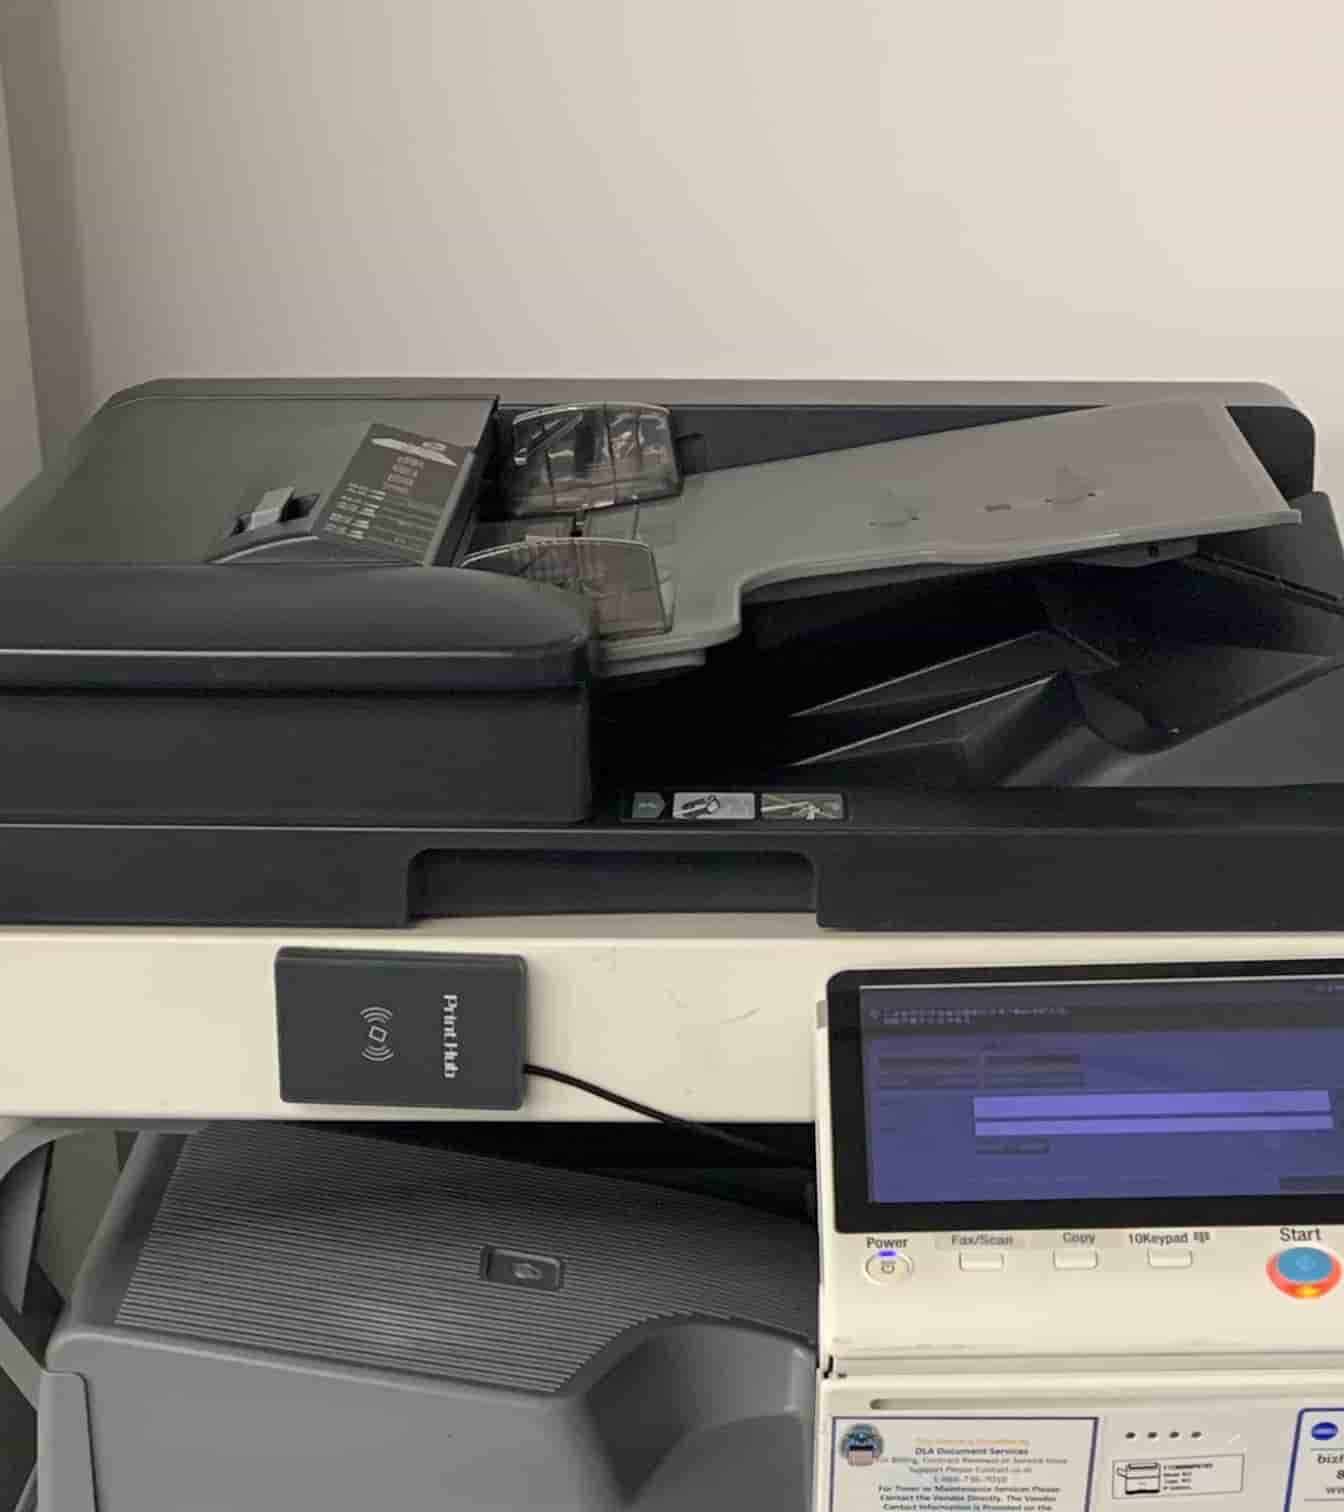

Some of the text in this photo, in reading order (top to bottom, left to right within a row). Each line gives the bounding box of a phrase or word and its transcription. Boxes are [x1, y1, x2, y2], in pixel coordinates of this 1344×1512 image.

[443, 994, 459, 1079] Print Hub
[951, 1234, 1014, 1246] Fax/Scan
[1062, 1232, 1096, 1245] Copy
[1279, 1227, 1323, 1242] Start
[866, 1236, 908, 1249] Power
